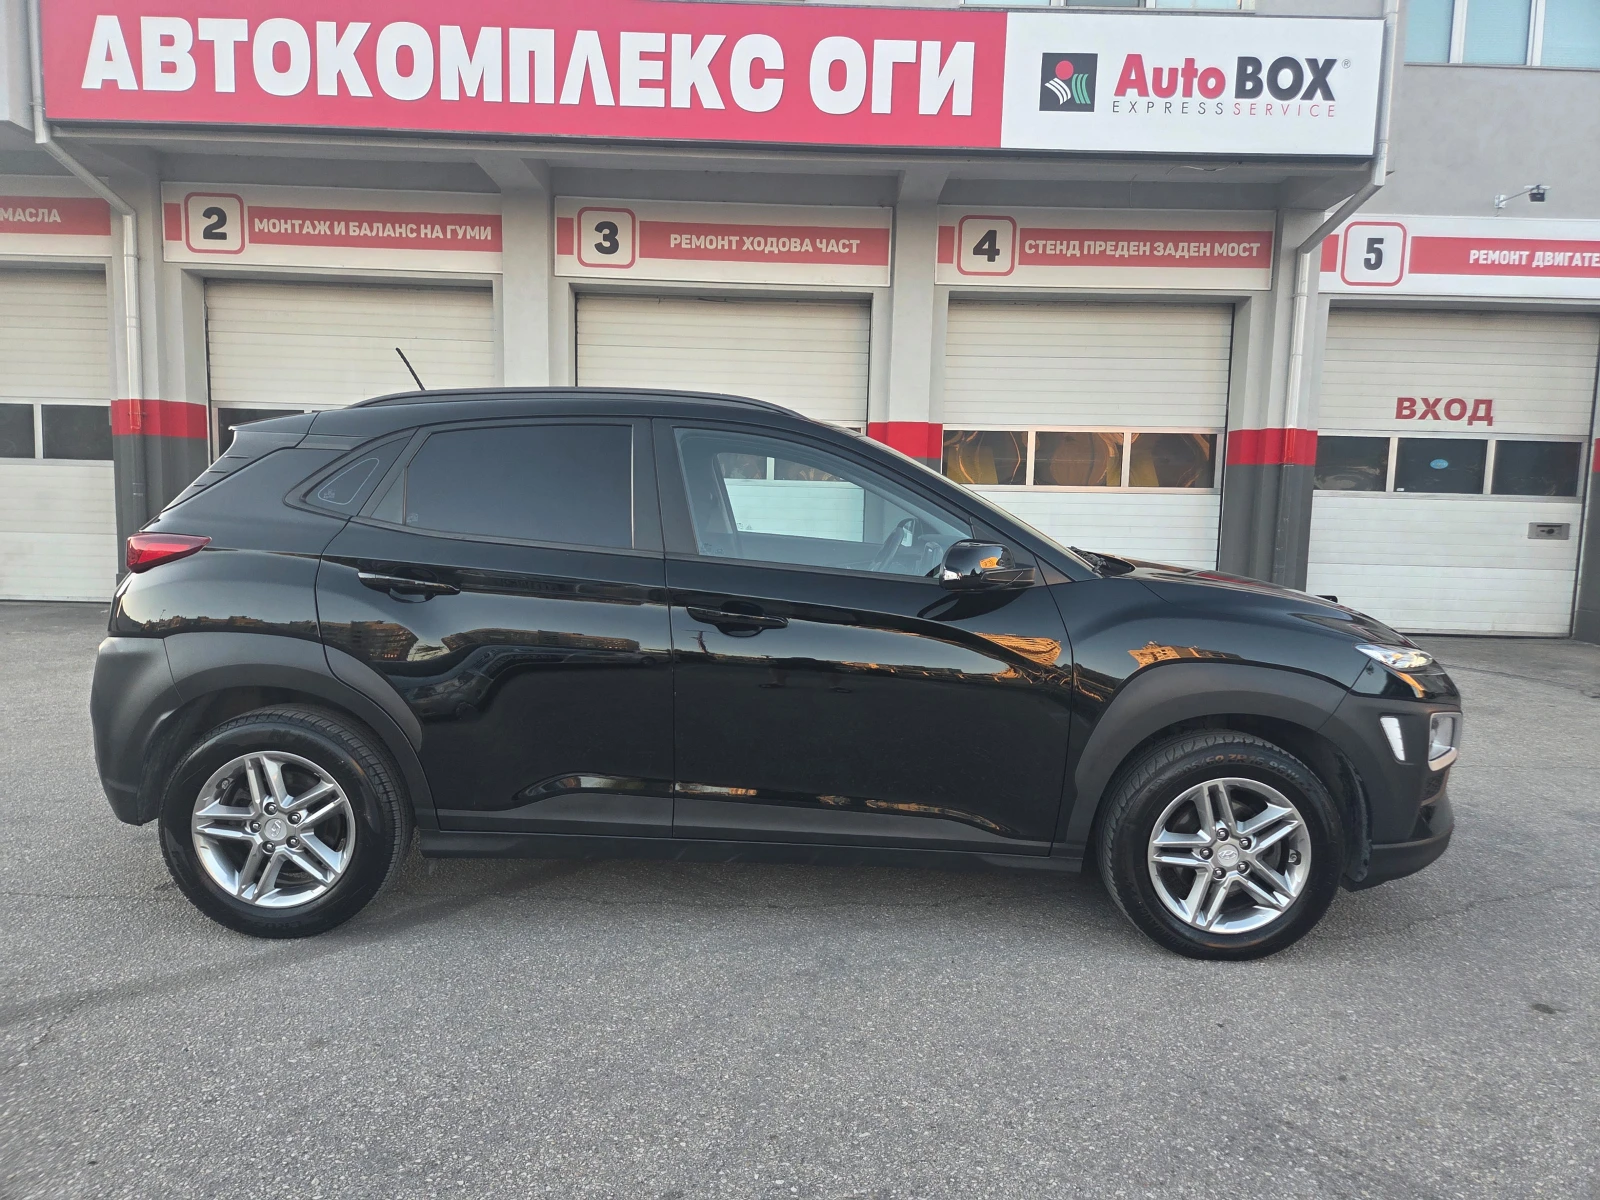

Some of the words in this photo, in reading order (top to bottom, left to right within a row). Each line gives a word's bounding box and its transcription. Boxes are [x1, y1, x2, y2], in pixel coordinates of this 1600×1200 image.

[81, 14, 786, 114] АВТОКОМПЛЕКС
[808, 36, 975, 117] ОГИ
[1113, 53, 1227, 100] Auto
[1234, 55, 1338, 102] BOX
[0, 207, 62, 223] МАСЛА
[202, 206, 228, 241] 2
[253, 217, 331, 236] МОНТАЖ
[334, 221, 346, 236] И
[349, 221, 418, 239] БАЛАНС
[420, 224, 444, 240] НА
[446, 225, 492, 241] ГУМИ
[593, 220, 620, 256] 3
[669, 233, 740, 251] РЕМОНТ
[742, 236, 813, 254] ХОДОВА
[816, 238, 861, 254] ЧАСТ
[972, 229, 1001, 263] 4
[1024, 239, 1081, 258] СТЕНД
[1083, 240, 1151, 259] ПРЕДЕН
[1153, 241, 1212, 259] ЗАДЕН
[1214, 242, 1261, 257] МОСТ
[1363, 236, 1385, 271] 5
[1469, 249, 1531, 267] РЕМОНТ
[1395, 396, 1494, 427] ВХОД
